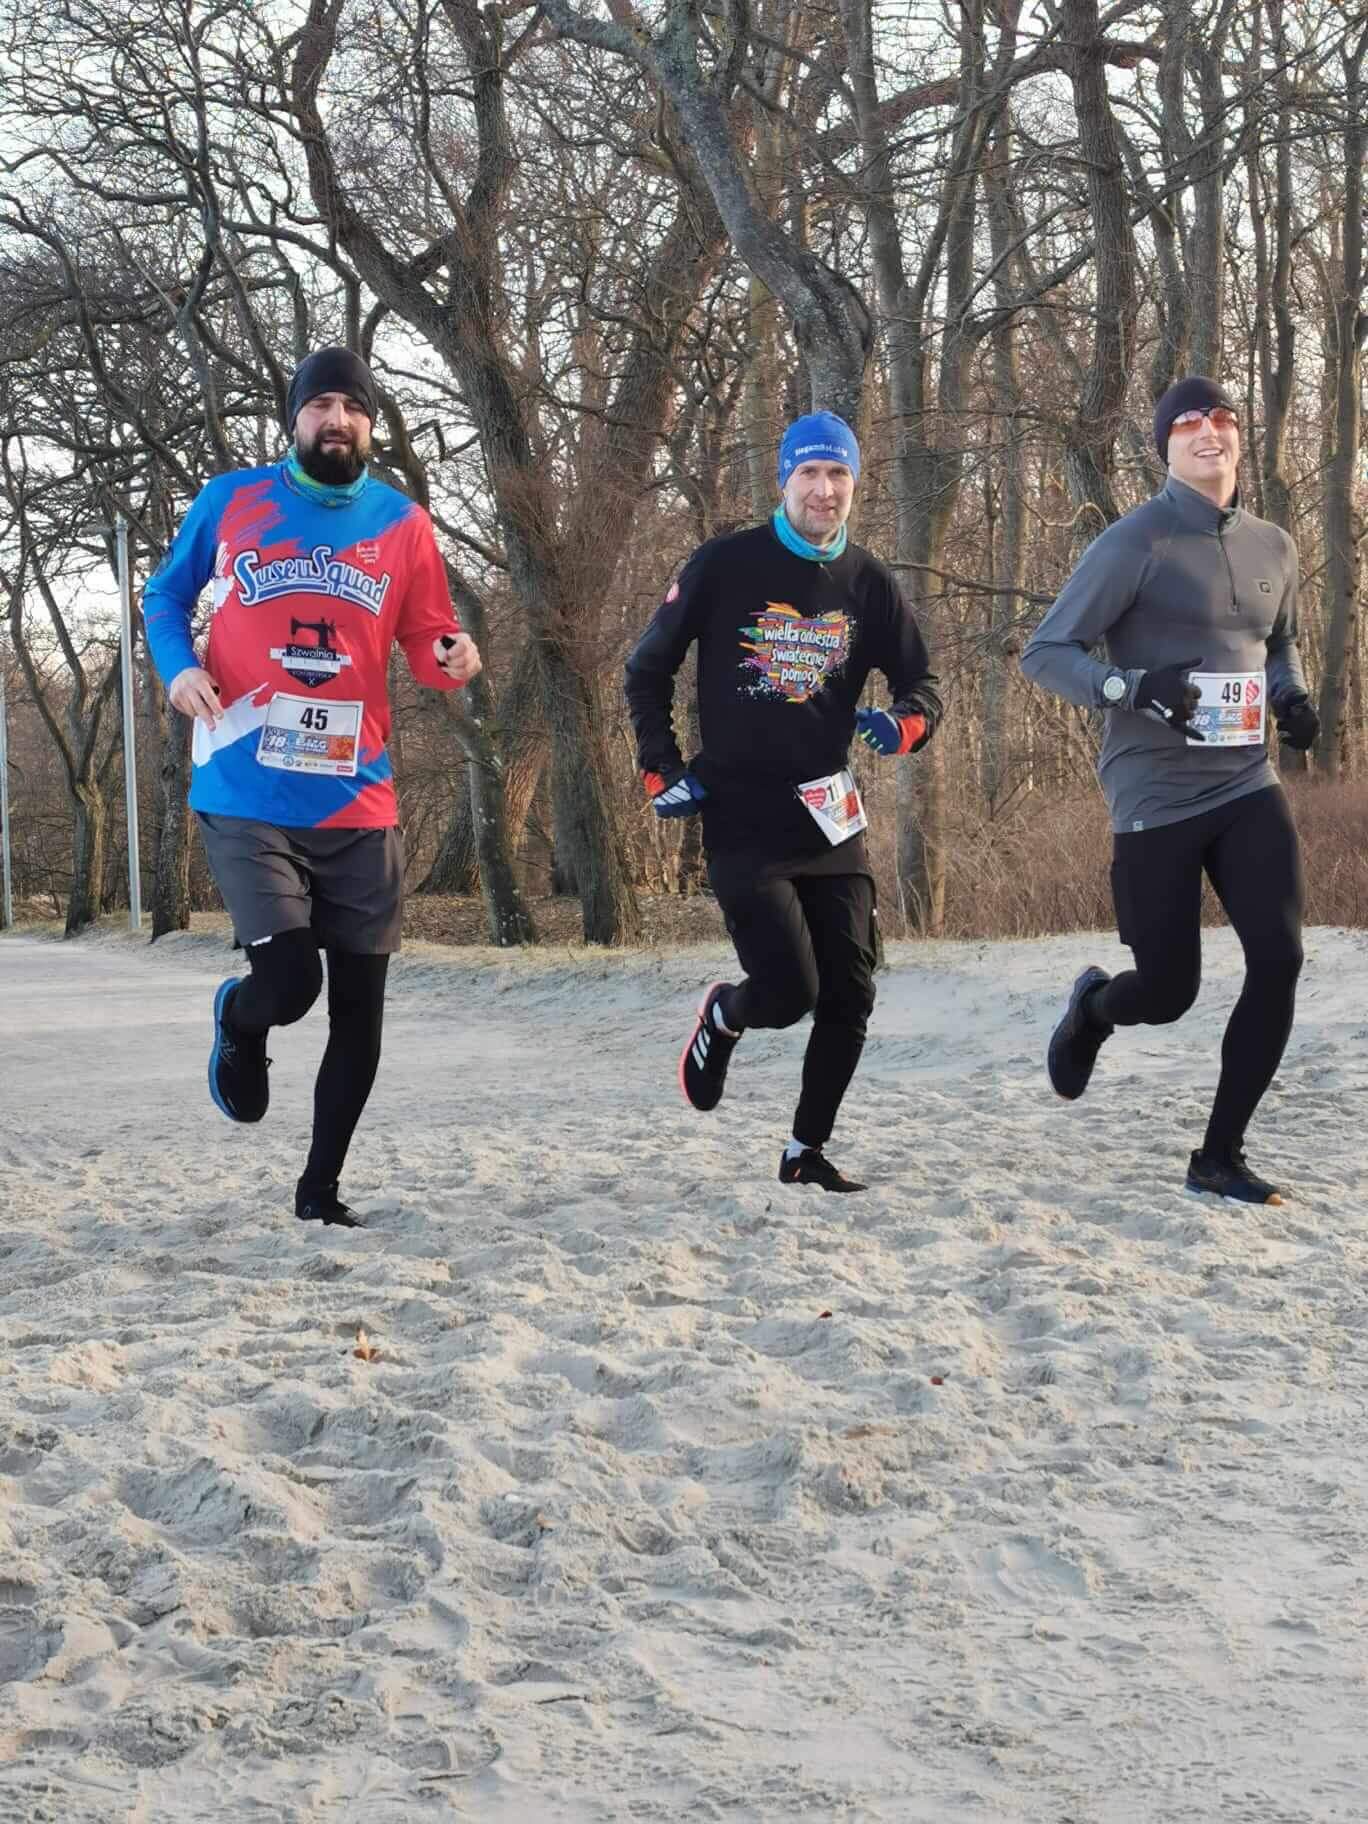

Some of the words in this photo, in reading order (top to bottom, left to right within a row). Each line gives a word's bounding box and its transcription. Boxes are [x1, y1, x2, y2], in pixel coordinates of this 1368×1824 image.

[764, 622, 799, 642] wielka
[291, 646, 334, 660] Szwalnia
[780, 667, 818, 688] pomocy
[1221, 682, 1242, 703] 49
[299, 707, 329, 731] 45
[268, 734, 286, 748] 18
